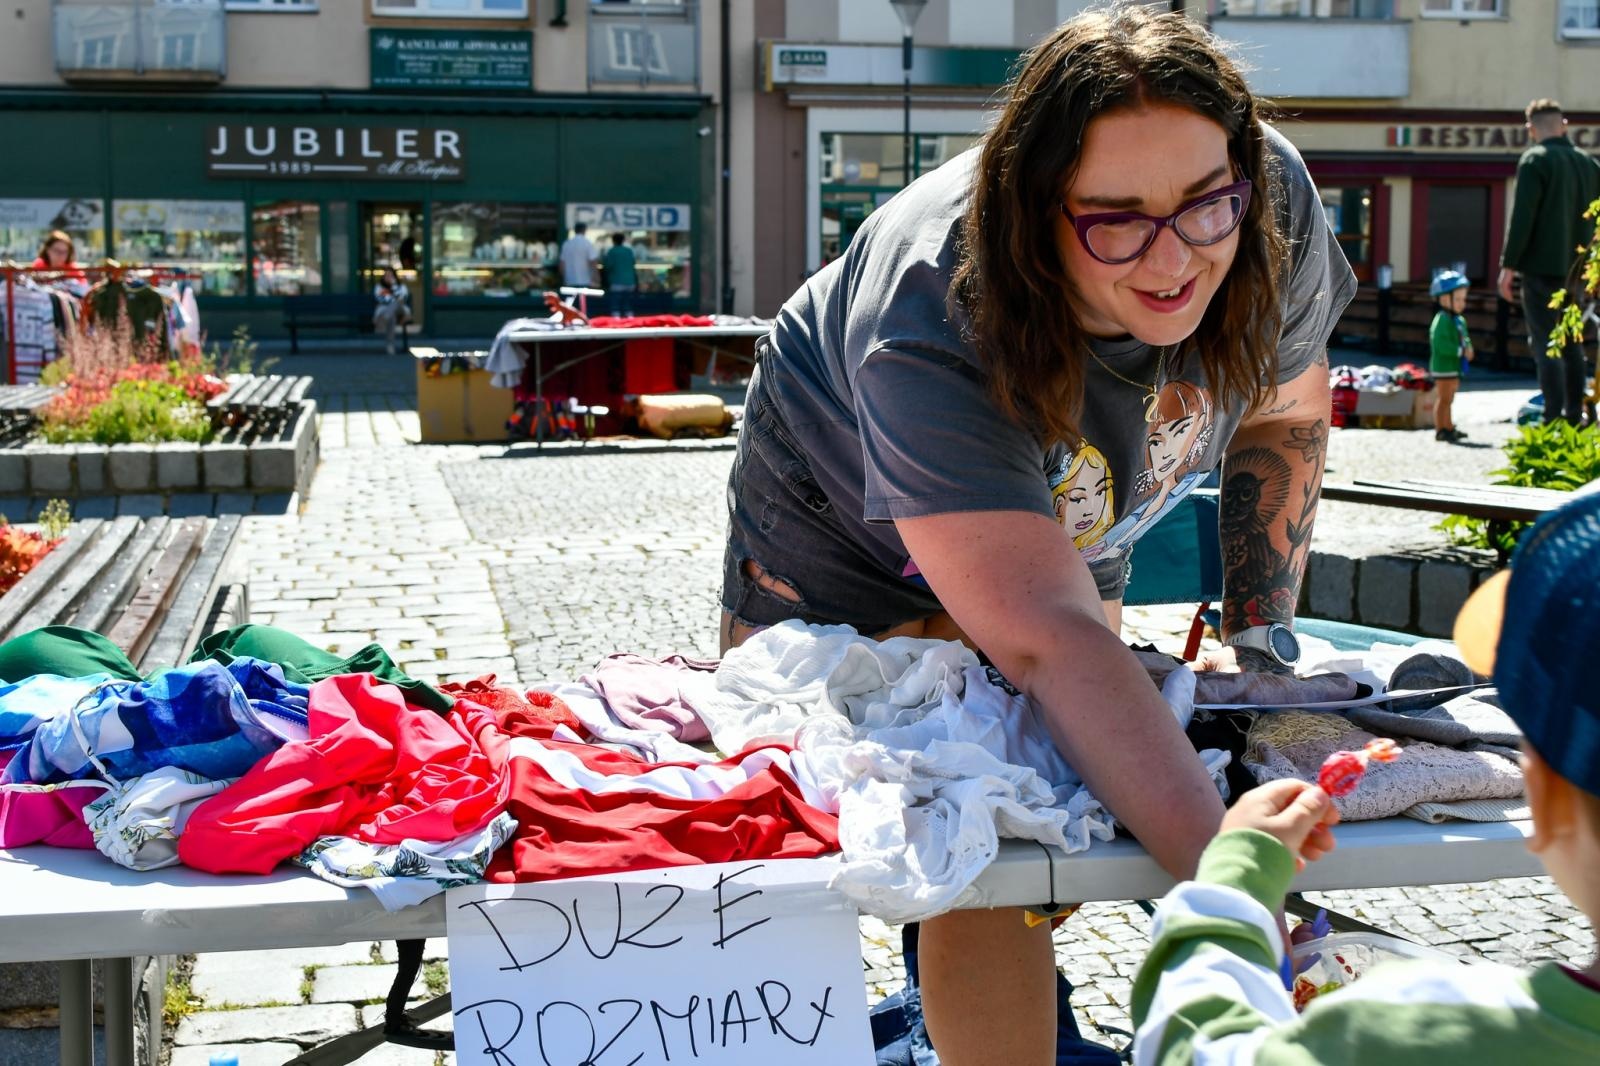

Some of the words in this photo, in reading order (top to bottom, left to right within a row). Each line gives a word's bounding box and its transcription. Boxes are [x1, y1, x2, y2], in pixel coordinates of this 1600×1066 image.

[211, 126, 462, 158] JUBILER
[269, 161, 312, 174] 1989
[574, 205, 679, 227] CASIO
